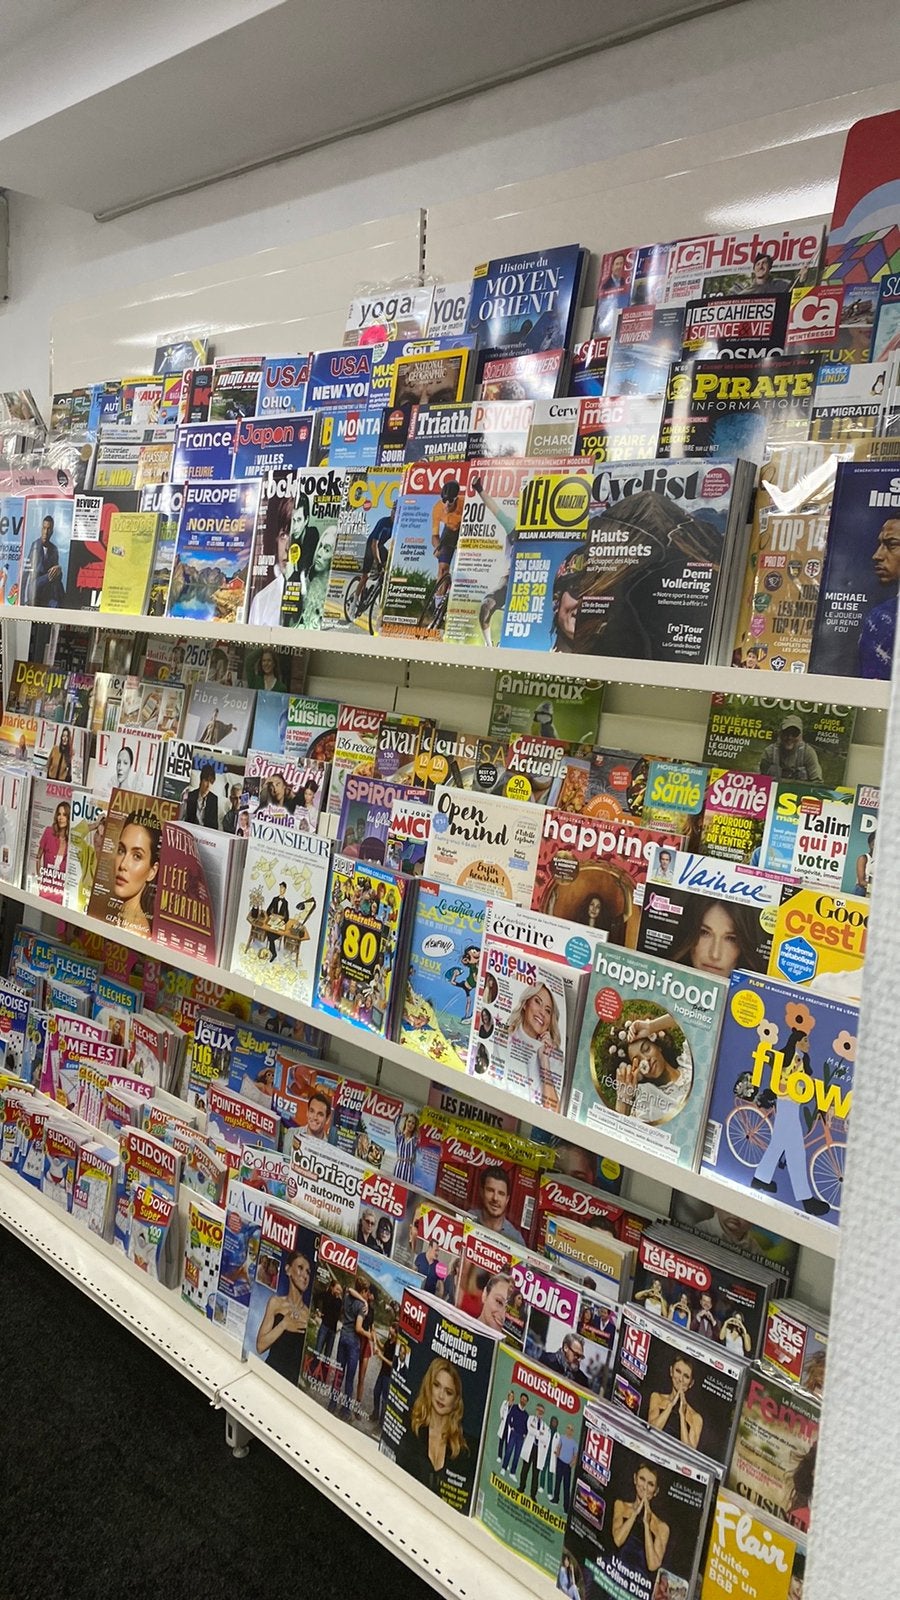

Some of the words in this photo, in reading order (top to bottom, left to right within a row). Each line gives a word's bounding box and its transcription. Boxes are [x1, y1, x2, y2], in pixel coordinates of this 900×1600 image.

[705, 231, 818, 269] Histoire
[500, 259, 533, 272] Histoire
[535, 258, 548, 268] du
[484, 268, 564, 299] MOYEN-
[359, 296, 412, 327] yoga
[479, 290, 559, 321] ORIENT
[693, 307, 714, 324] LES
[717, 303, 774, 322] CAHIERS
[690, 324, 739, 340] SCIENCE
[751, 321, 772, 337] VIE
[266, 365, 309, 388] USA
[331, 355, 370, 377] USA
[693, 373, 814, 400] PIRATE
[820, 375, 847, 384] LINUX
[262, 396, 291, 408] OHIO
[690, 398, 809, 411] INFORMATIQUE
[815, 407, 828, 418] LA
[582, 407, 624, 424] mac
[177, 430, 232, 448] France
[240, 424, 294, 446] Japon
[583, 436, 606, 448] TOUT
[609, 435, 646, 447] FAIRE
[256, 453, 284, 465] VILLES
[591, 469, 699, 501] Cyclist
[143, 492, 182, 511] EURO
[186, 489, 237, 504] EUROPE
[520, 476, 591, 527] VÉLO
[556, 494, 587, 509] MAGAZINE
[188, 515, 246, 532] NORVÈGE
[463, 503, 485, 523] 200
[460, 524, 496, 538] CONSEILS
[519, 531, 539, 540] JULIAN
[538, 531, 581, 540] ALAPHILIPPE
[590, 529, 629, 543] Hauts
[589, 544, 652, 557] sommets
[515, 559, 528, 571] SON
[529, 559, 550, 571] CADEAU
[683, 568, 713, 580] Demi
[514, 571, 548, 583] POUR
[661, 578, 711, 593] Vollering
[512, 584, 529, 595] LES
[531, 583, 547, 595] 20
[825, 592, 868, 602] MICHAEL
[509, 597, 529, 612] ANS
[531, 597, 545, 611] DE
[824, 611, 836, 619] LE
[837, 612, 862, 620] JOUEUR
[831, 602, 858, 611] OLISE
[507, 611, 543, 623] L'ÉQUIPE
[826, 618, 838, 626] QUI
[505, 623, 530, 637] FDJ
[667, 624, 704, 636] [re]Tour
[498, 675, 586, 700] Animaux
[296, 699, 319, 711] Maxi
[288, 705, 336, 728] Cuisine
[338, 705, 384, 731] Maxi
[713, 715, 762, 728] RIVIÈRES
[820, 718, 841, 727] GUIDE
[710, 735, 750, 745] L'ALAGNON
[712, 725, 726, 734] DE
[727, 726, 773, 740] FRANCE
[815, 736, 839, 744] PRADIER
[817, 731, 839, 740] PASCAL
[512, 736, 564, 761] Cuisine
[708, 749, 737, 758] L'AGOUT
[250, 756, 325, 793] Starlight
[508, 755, 567, 778] Actuelle
[656, 763, 703, 776] HORS-SÉRIE
[667, 771, 689, 784] TOP
[508, 787, 529, 796] RECETTES
[514, 778, 525, 790] 90
[651, 776, 701, 807] Santé
[726, 773, 754, 788] TOP
[111, 790, 179, 821] ANTI-AGE
[710, 781, 767, 812] Santé
[72, 795, 103, 823] plus
[399, 807, 410, 815] LE
[412, 810, 430, 819] JOUR
[437, 792, 487, 824] Open
[711, 825, 721, 835] JE
[721, 826, 751, 839] PRENDS
[713, 814, 753, 829] POURQUOI
[251, 822, 331, 858] MONSIEUR
[448, 820, 509, 846] mind
[707, 833, 718, 843] DU
[719, 835, 746, 848] VENTRE
[799, 834, 827, 853] qui
[798, 854, 839, 871] votre
[163, 863, 187, 892] L'ÉTÉ
[160, 894, 211, 929] MEURTRIER
[344, 906, 382, 930] Génération
[493, 917, 554, 949] écrire
[785, 910, 856, 950] C'est
[342, 924, 378, 964] 80
[784, 943, 814, 958] Syndrome
[56, 957, 97, 981] FLÉCHÉS
[489, 949, 537, 978] mieux
[781, 950, 815, 966] métabolique
[99, 983, 132, 1006] FLÉCHÉS
[749, 980, 765, 988] FLOW
[673, 1004, 713, 1023] happinez
[195, 1020, 235, 1050] Jeux
[67, 1037, 114, 1061] MÊLÉS
[192, 1044, 212, 1064] 116
[192, 1063, 220, 1080] PAGES
[751, 1041, 852, 1119] flow
[212, 1094, 241, 1115] POINTS
[246, 1108, 274, 1133] RELIER
[363, 1090, 402, 1119] Maxi
[440, 1094, 457, 1114] LES
[458, 1099, 504, 1129] ENFANTS
[48, 1130, 77, 1151] SUDOKU
[130, 1133, 175, 1172] SUDOKU
[81, 1152, 112, 1176] SUDOKU
[136, 1186, 171, 1216] SUDOKU
[297, 1176, 309, 1188] Un
[310, 1183, 355, 1209] automne
[304, 1192, 342, 1215] magique
[361, 1184, 404, 1217] Paris
[140, 1206, 161, 1222] Super
[189, 1215, 223, 1241] SUKO
[262, 1210, 297, 1250] MATCH
[320, 1241, 358, 1271] Gala
[474, 1240, 508, 1265] France
[547, 1235, 557, 1246] Dr
[558, 1240, 586, 1261] Albert
[587, 1253, 615, 1275] Caron
[642, 1241, 707, 1286] Télépro
[512, 1265, 572, 1320] Public
[403, 1300, 427, 1323] soir
[434, 1323, 478, 1357] L'aventure
[771, 1315, 804, 1348] Télé
[769, 1330, 801, 1357] Star
[431, 1338, 477, 1372] américaine
[516, 1366, 575, 1410] moustique
[491, 1472, 519, 1500] Trouver
[520, 1494, 531, 1509] un
[532, 1504, 566, 1531] médecin
[715, 1501, 788, 1573] Flair
[612, 1555, 652, 1589] L'émotion
[712, 1544, 750, 1579] Nuitée
[596, 1556, 606, 1569] de
[606, 1564, 628, 1588] Céline
[630, 1582, 650, 1600] Dion
[708, 1566, 733, 1594] B&B
[710, 1557, 739, 1586] dans
[741, 1581, 757, 1598] un
